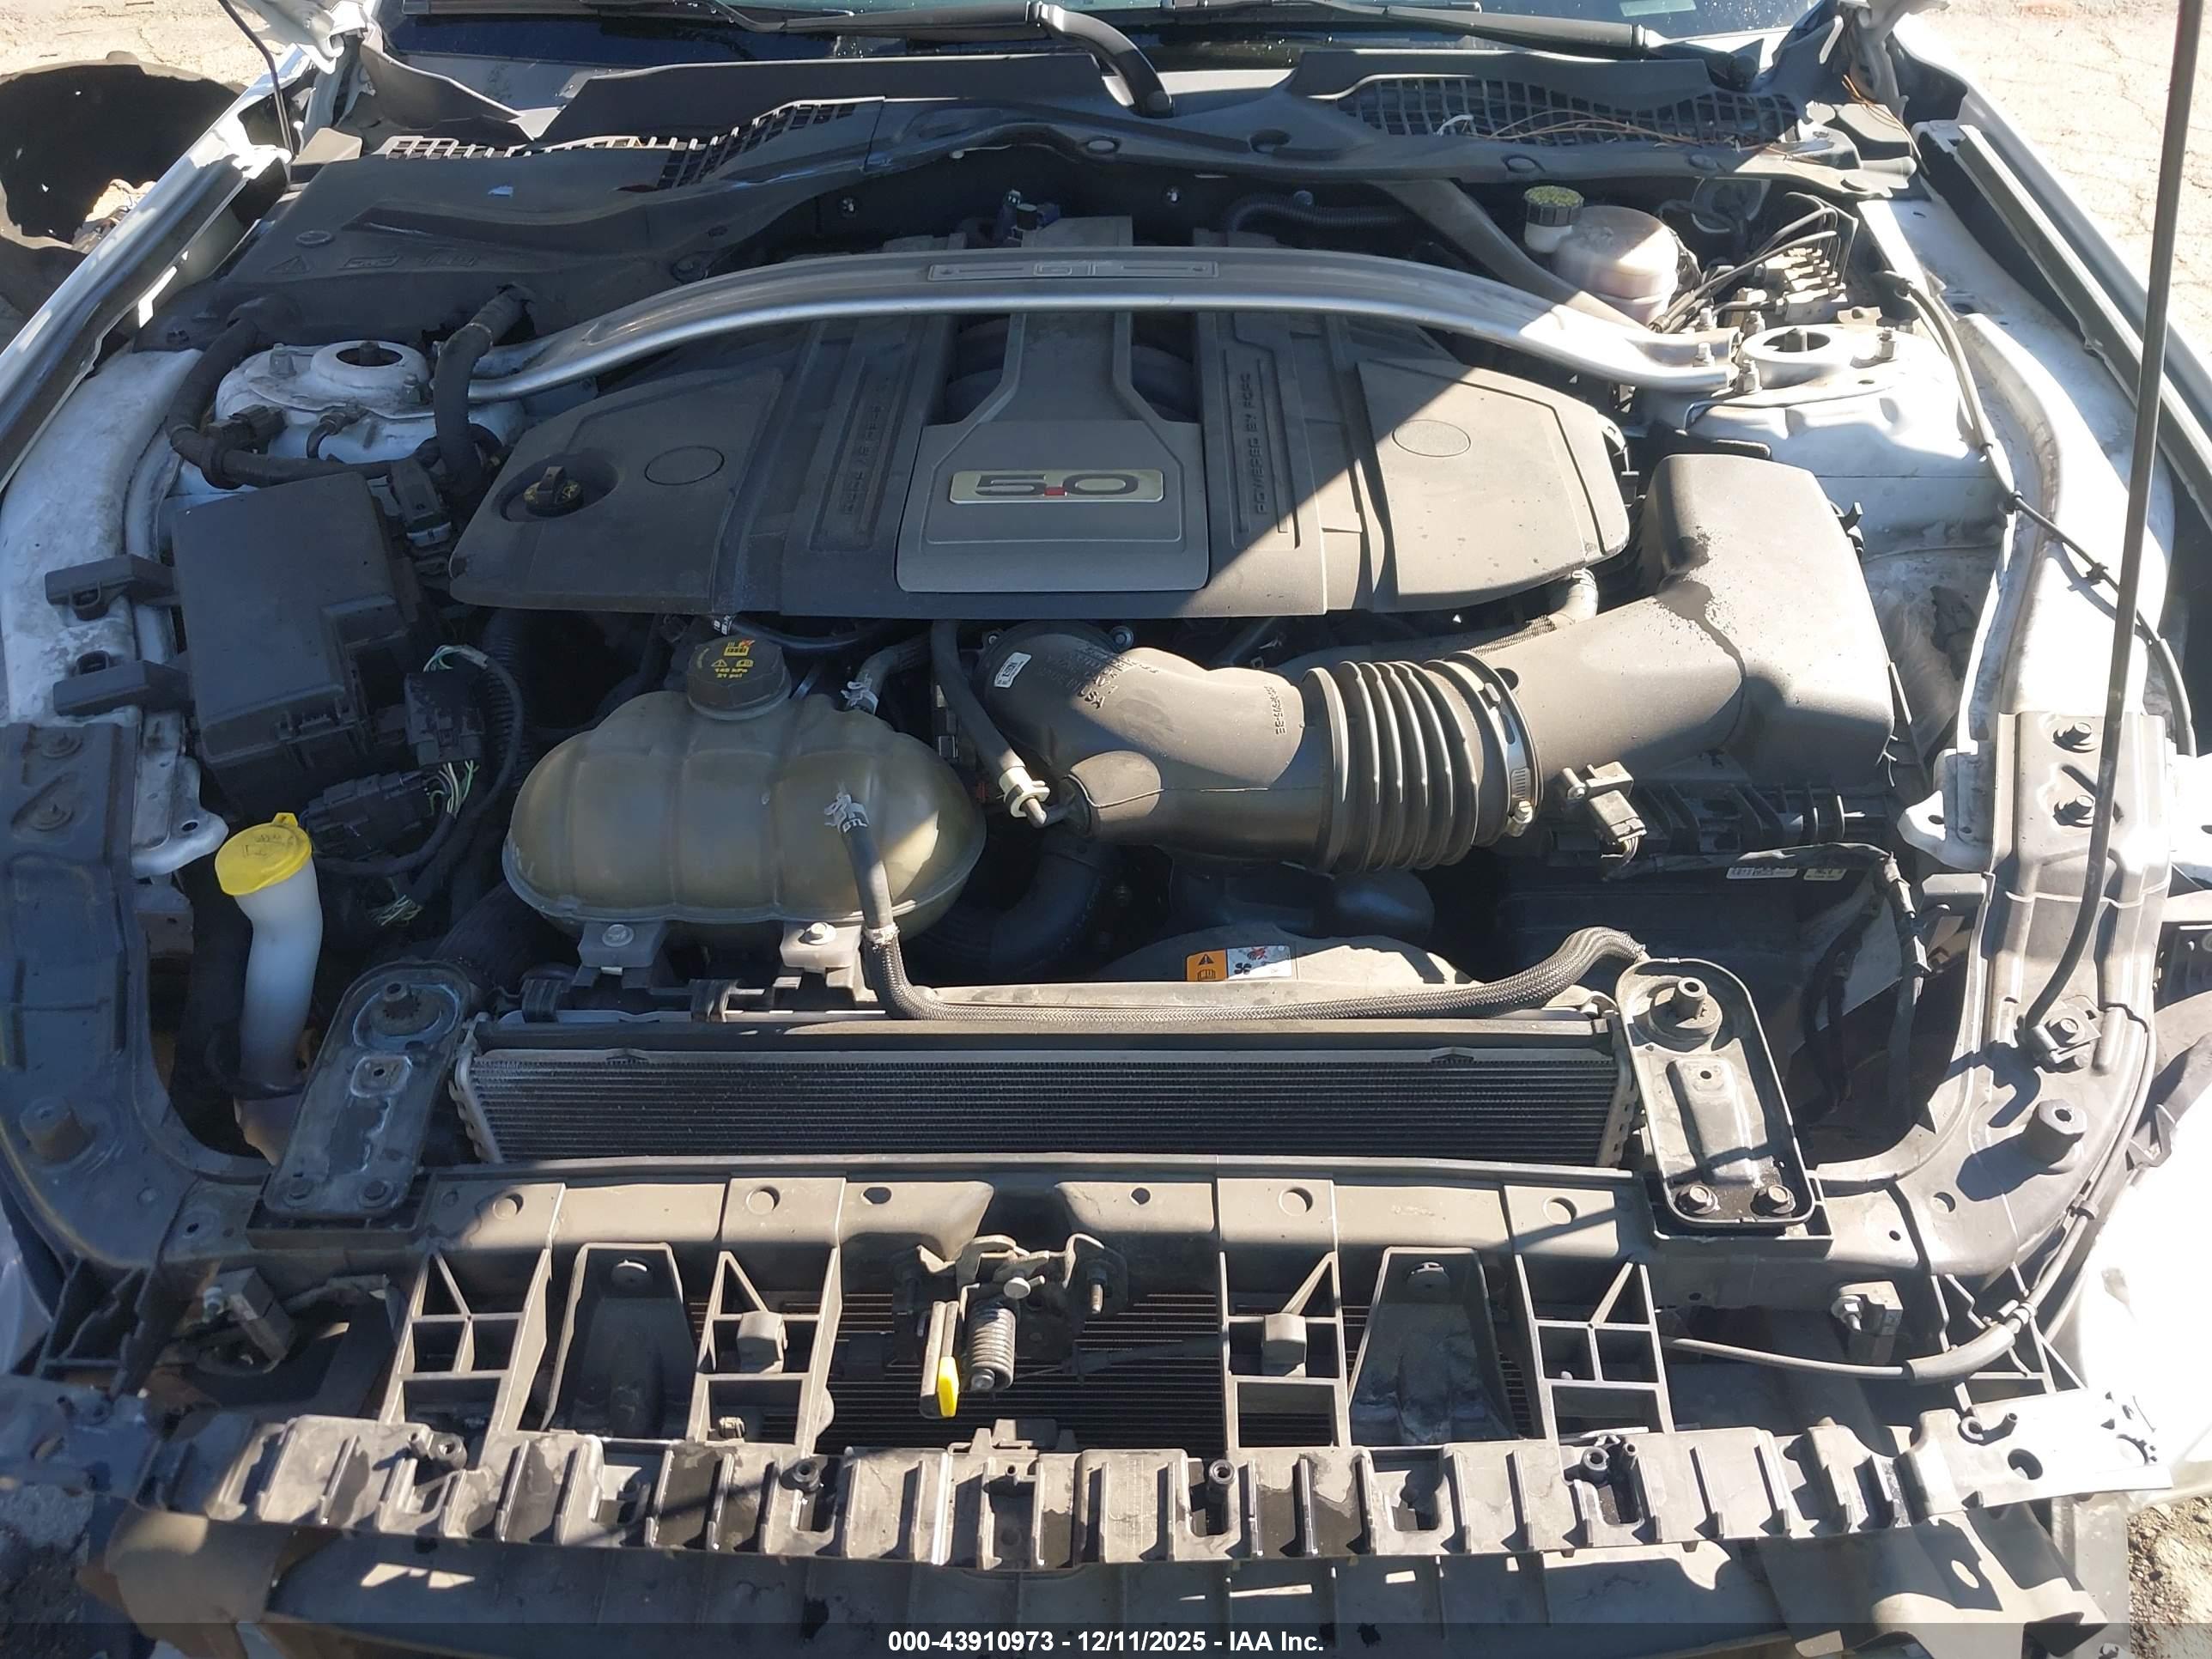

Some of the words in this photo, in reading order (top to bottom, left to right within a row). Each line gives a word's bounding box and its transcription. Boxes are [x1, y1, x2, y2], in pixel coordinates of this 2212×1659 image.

[975, 474, 1139, 497] 5.0
[1248, 438, 1268, 515] POWERED
[1078, 684, 1107, 710] USA
